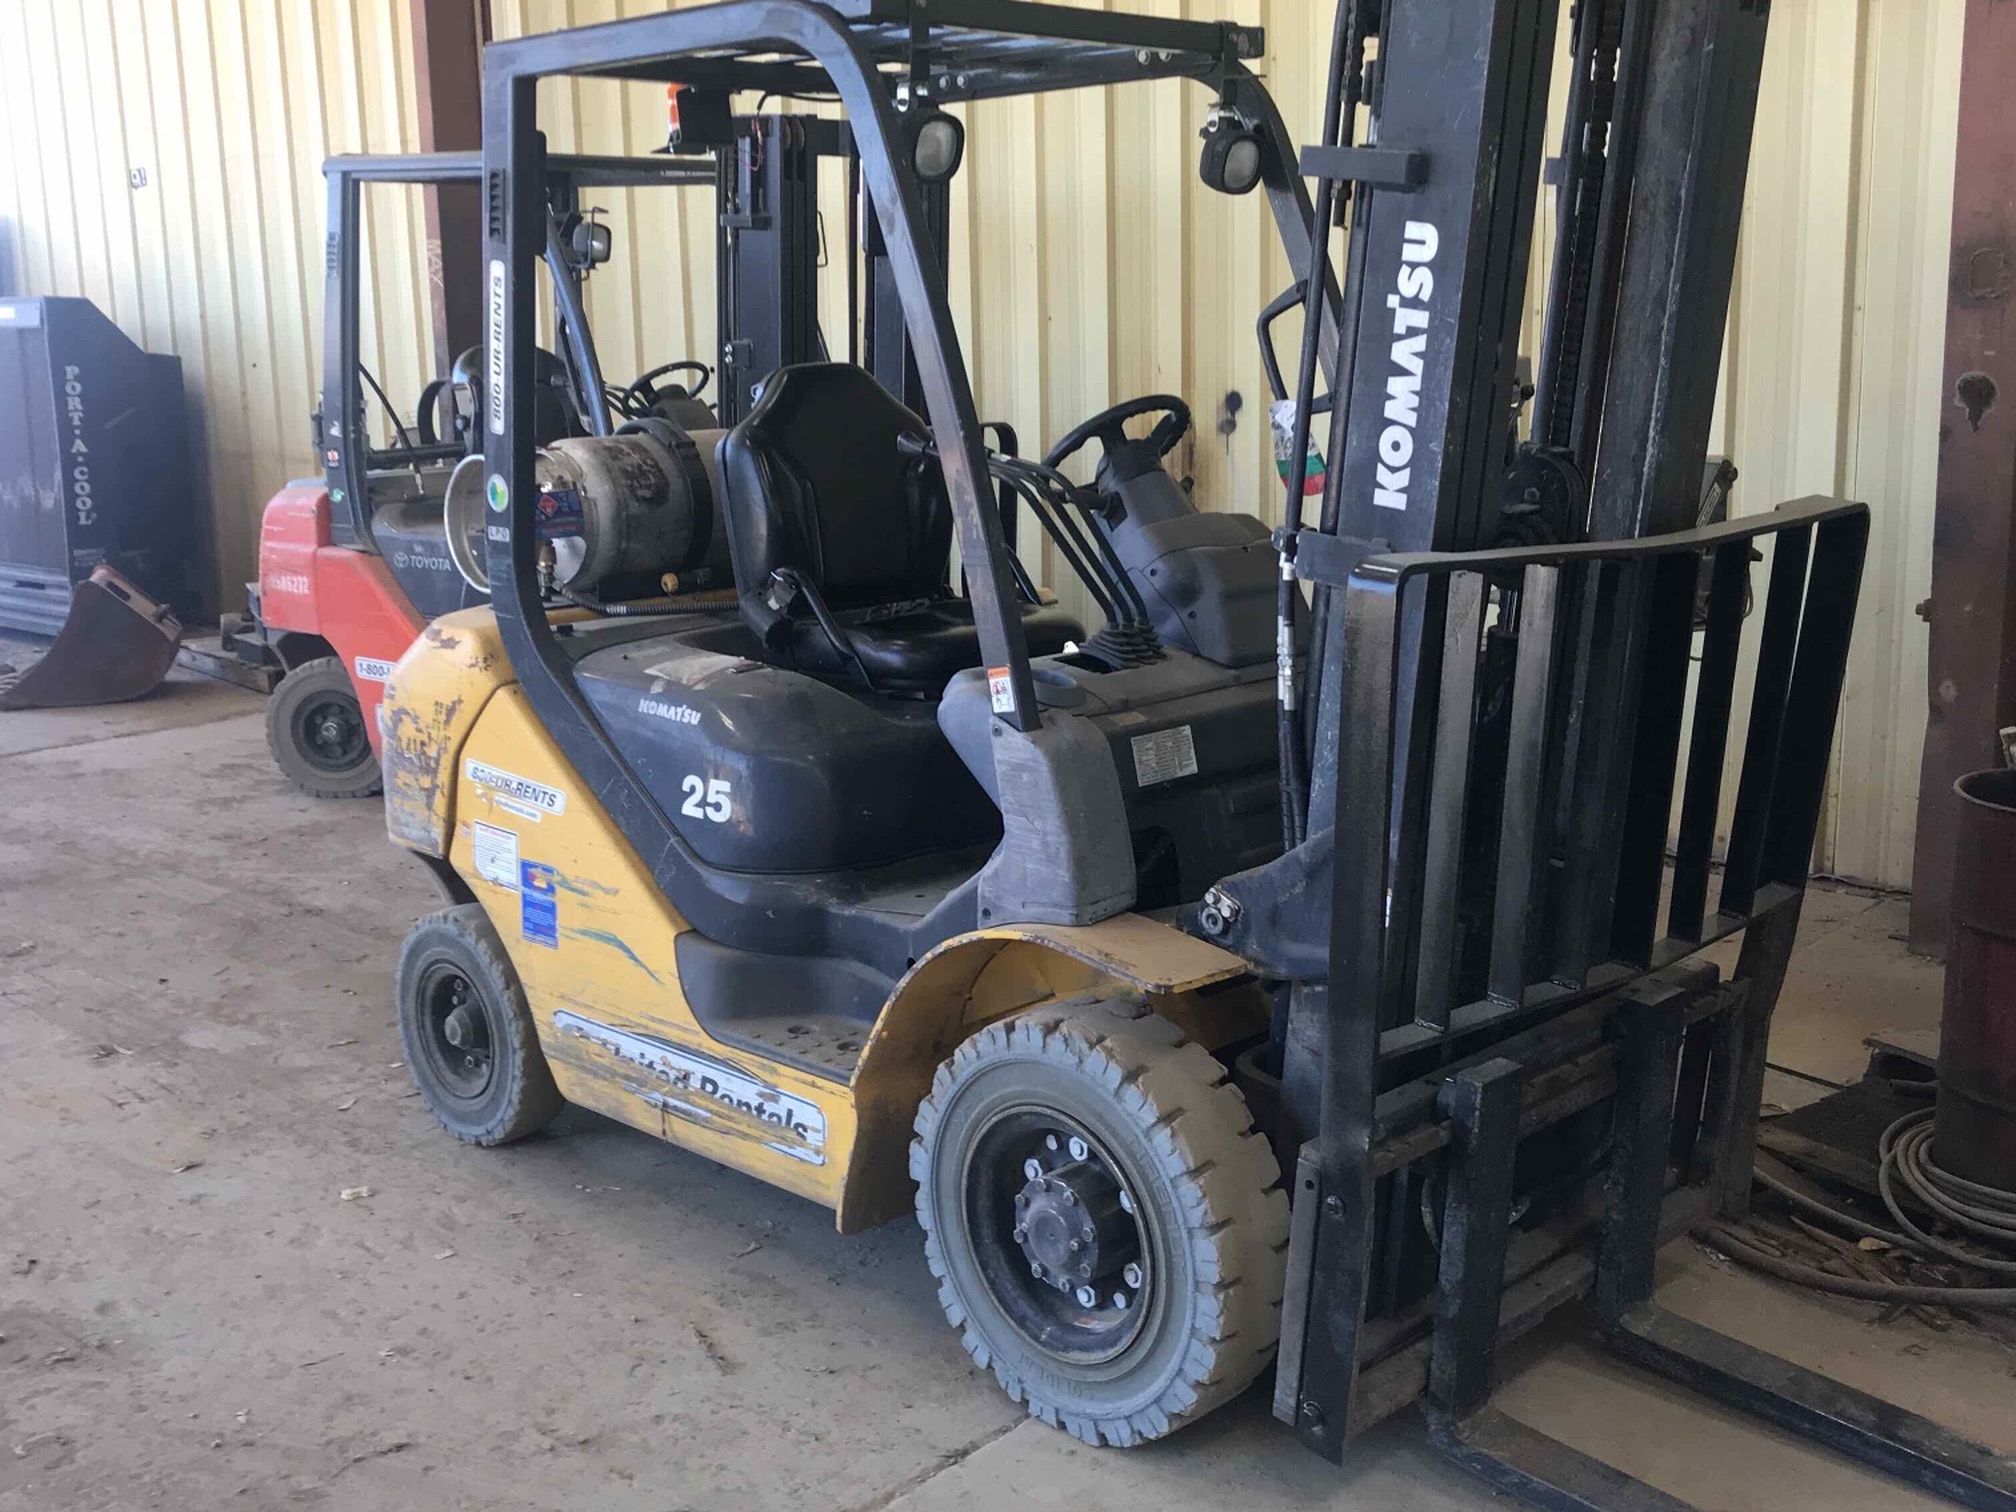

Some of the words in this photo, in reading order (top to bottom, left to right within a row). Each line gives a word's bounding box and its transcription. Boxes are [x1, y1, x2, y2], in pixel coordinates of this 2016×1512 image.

[493, 277, 502, 421] 800-UR-RENTS
[1373, 220, 1439, 511] KOMATSU
[410, 555, 450, 571] TOYOTA
[638, 699, 701, 725] KOMATSU
[681, 774, 732, 823] 25
